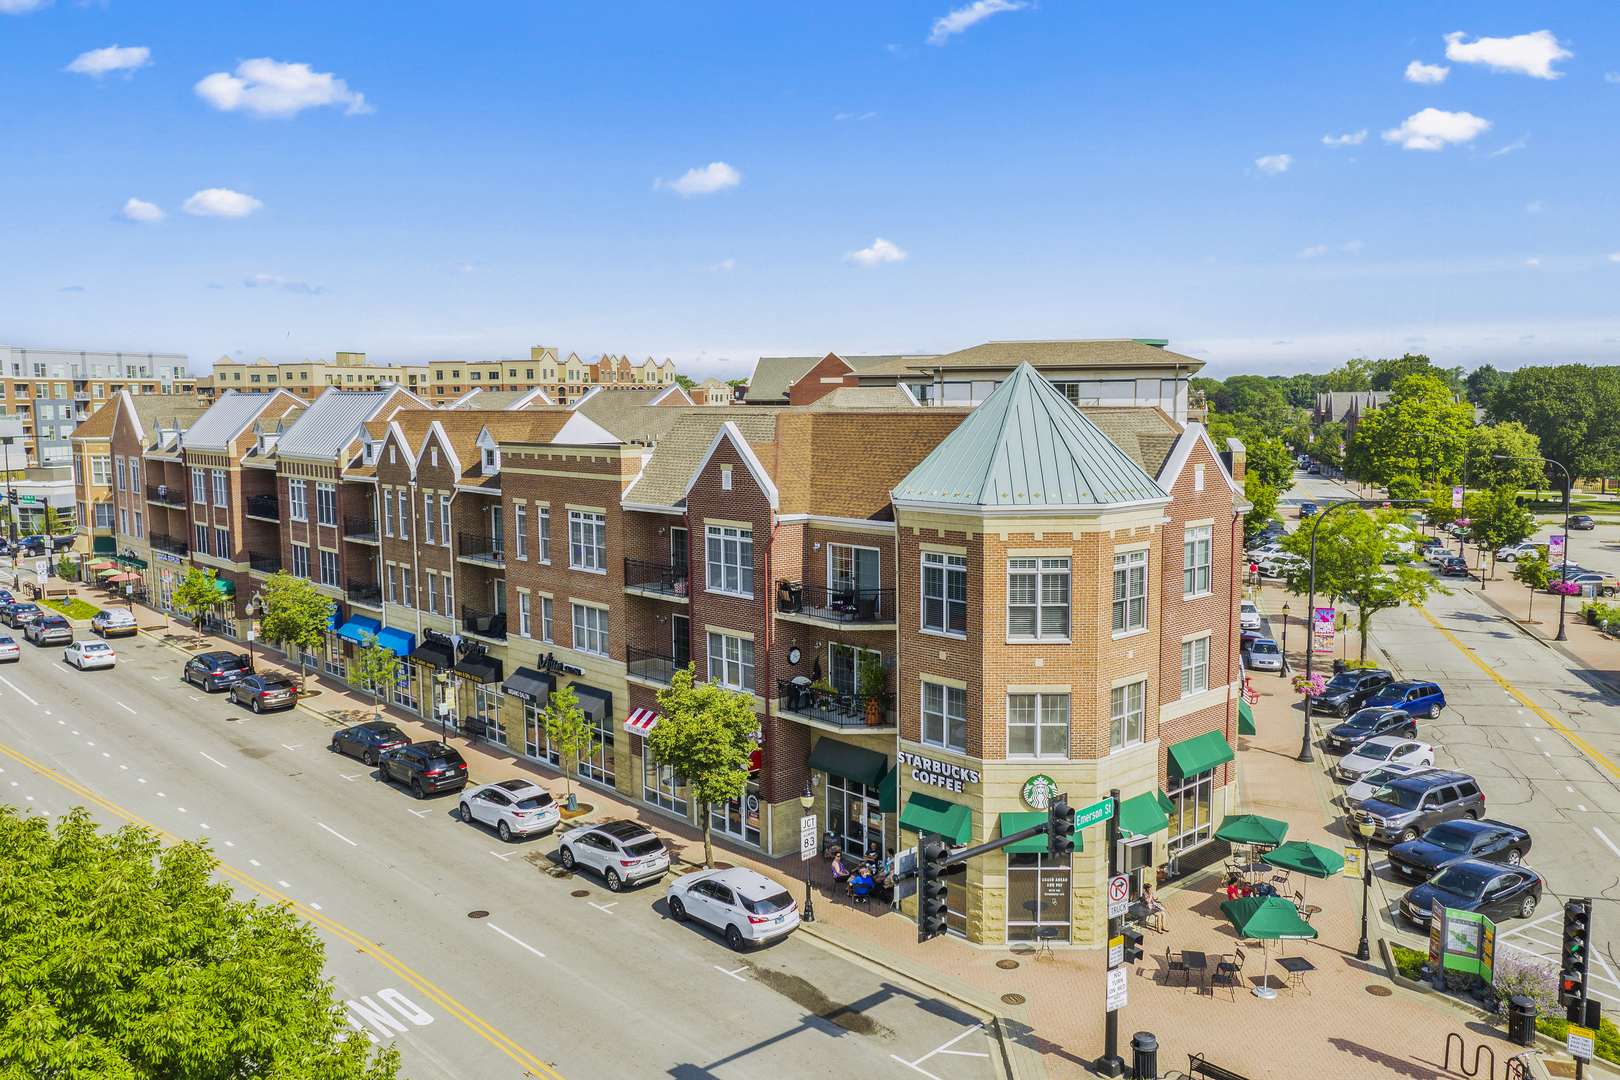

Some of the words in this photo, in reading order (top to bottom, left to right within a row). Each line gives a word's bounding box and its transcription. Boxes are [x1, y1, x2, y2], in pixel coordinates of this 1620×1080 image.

[898, 751, 979, 784] STARBUCKS
[911, 769, 962, 793] COFFEE
[1076, 808, 1103, 826] Emerson
[1104, 803, 1112, 815] St
[803, 818, 814, 828] JCT
[804, 836, 814, 848] 83
[1110, 903, 1126, 915] TRUCK
[1111, 977, 1124, 987] TURN
